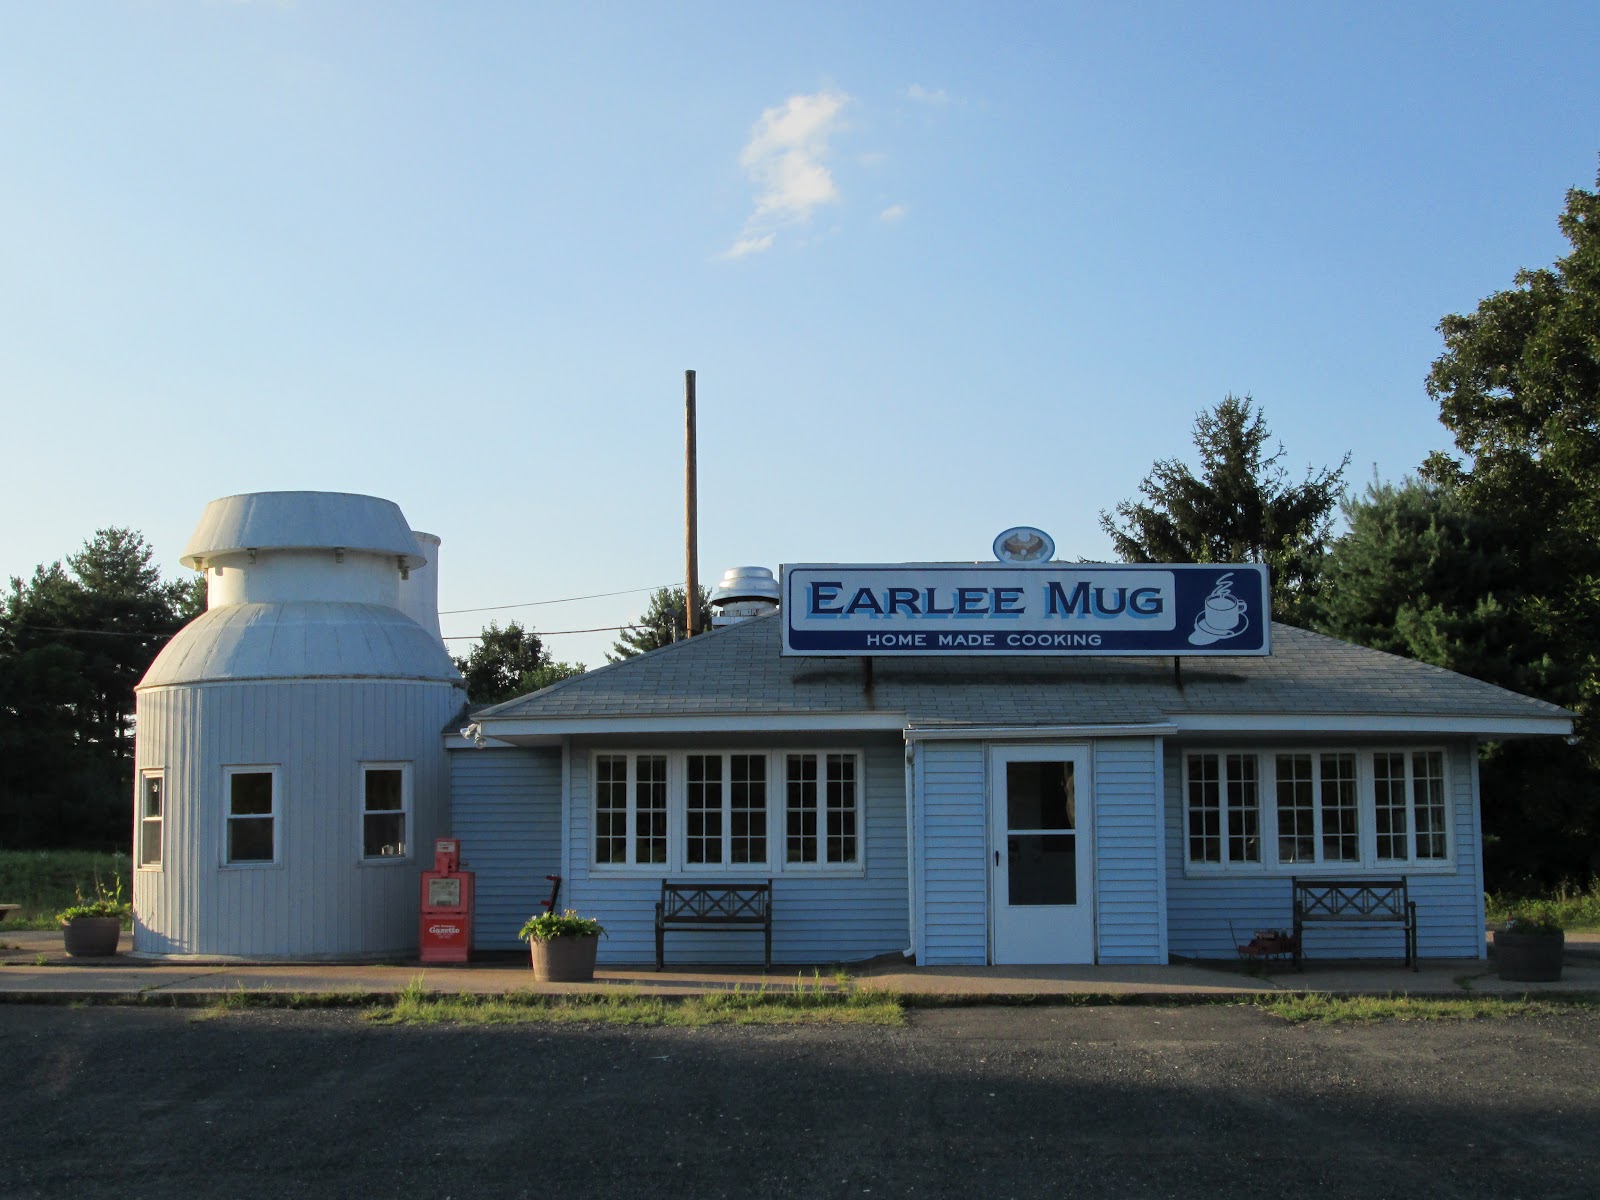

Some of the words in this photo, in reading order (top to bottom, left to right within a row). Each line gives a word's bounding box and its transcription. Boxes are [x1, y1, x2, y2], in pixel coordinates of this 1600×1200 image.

[803, 581, 1027, 617] EARLEE
[1044, 581, 1164, 617] MUG
[866, 634, 927, 646] HOME
[938, 634, 995, 646] MADE
[1006, 634, 1102, 646] COOKING
[429, 926, 460, 934] Gazette
